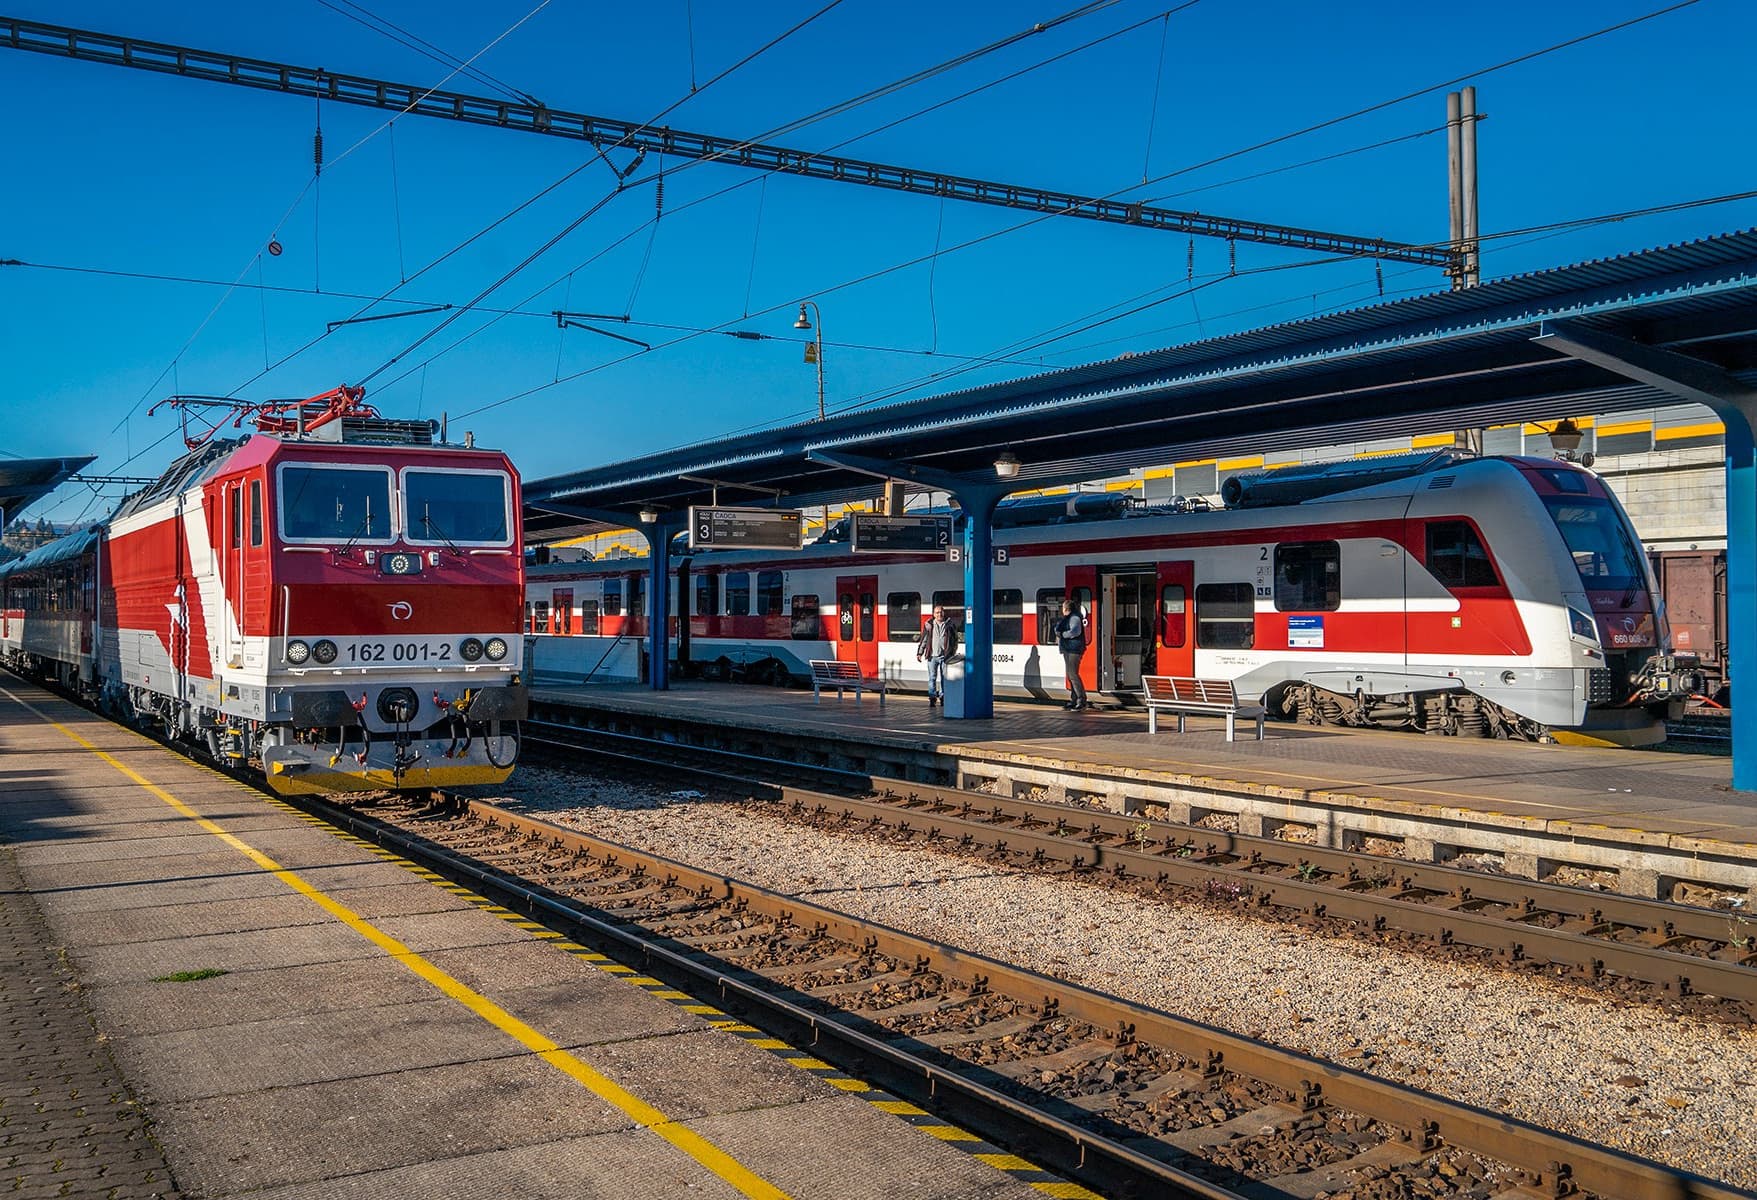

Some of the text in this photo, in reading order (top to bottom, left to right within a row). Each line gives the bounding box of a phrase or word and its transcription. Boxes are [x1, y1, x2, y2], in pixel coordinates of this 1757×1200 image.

[700, 524, 709, 539] 3
[939, 531, 948, 544] 2
[950, 549, 960, 562] B
[998, 549, 1007, 562] B
[1260, 546, 1268, 560] 2
[347, 643, 451, 661] 162 001-2
[998, 654, 1014, 662] 008-4
